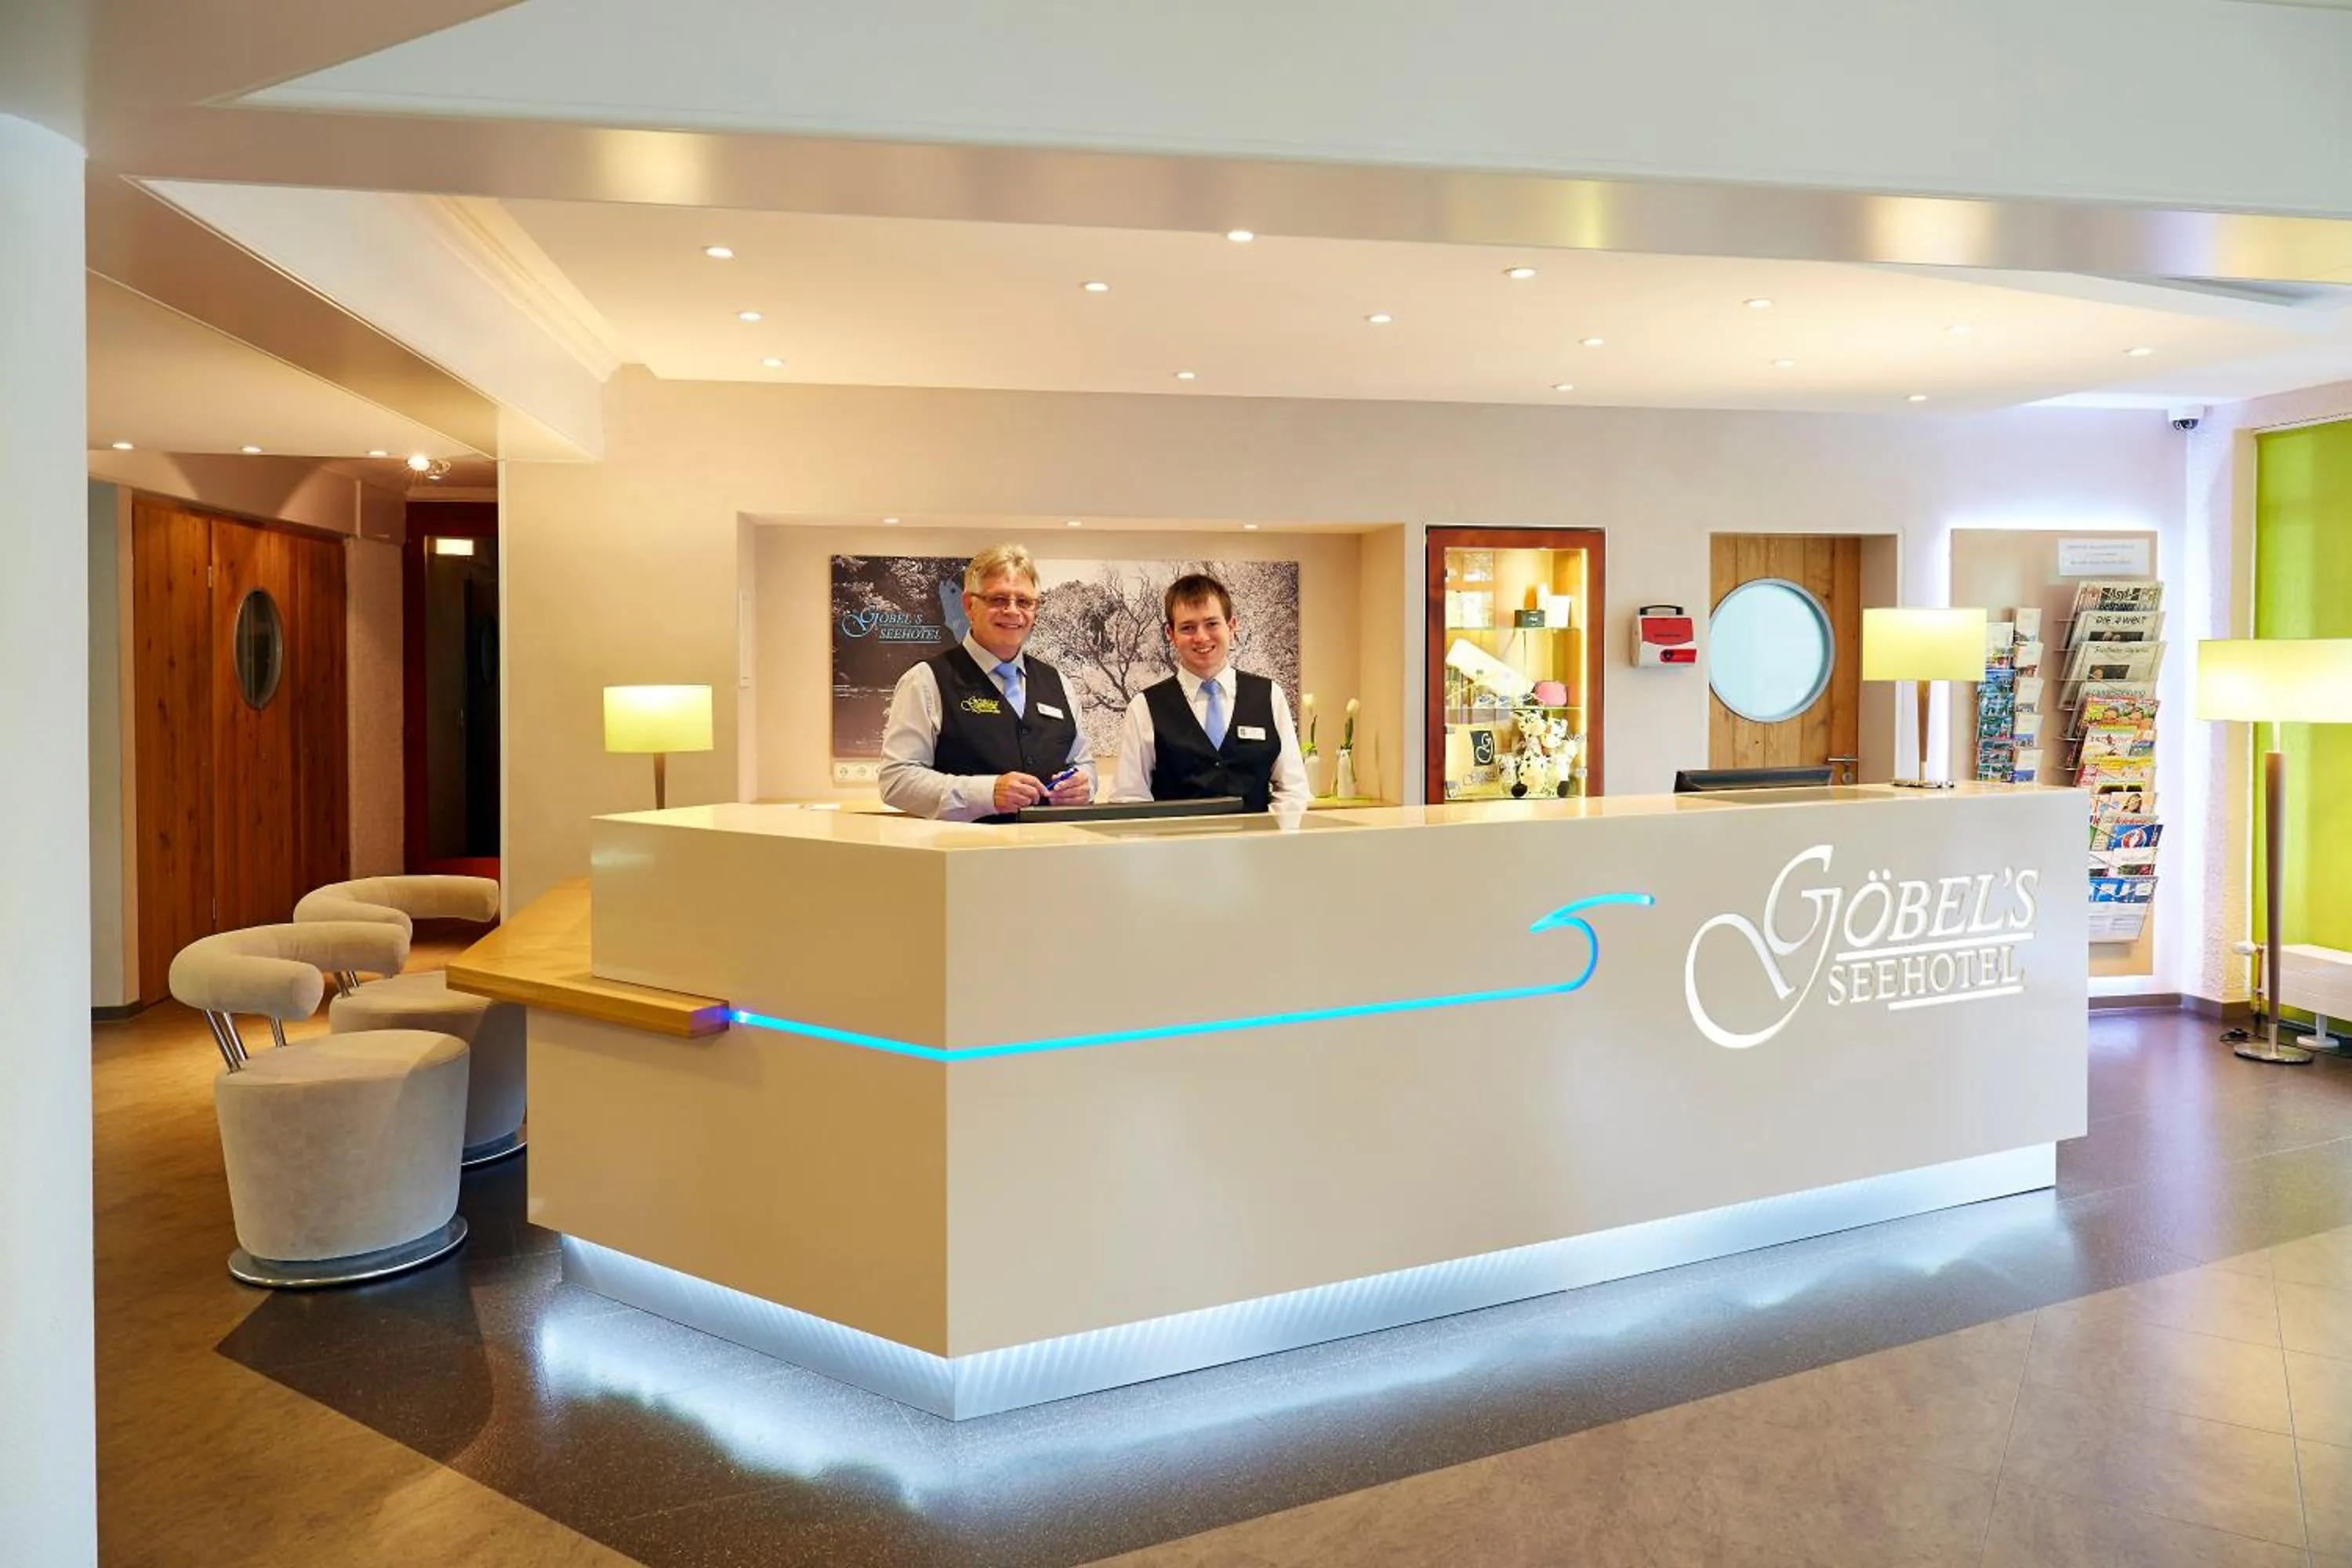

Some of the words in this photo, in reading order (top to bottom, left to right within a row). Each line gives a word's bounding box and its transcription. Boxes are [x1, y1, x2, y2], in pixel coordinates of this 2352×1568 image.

[878, 628, 942, 640] SEEHOTEL
[1684, 844, 2040, 1049] GÖBEL'S
[1828, 945, 2025, 1007] SEEHOTEL
